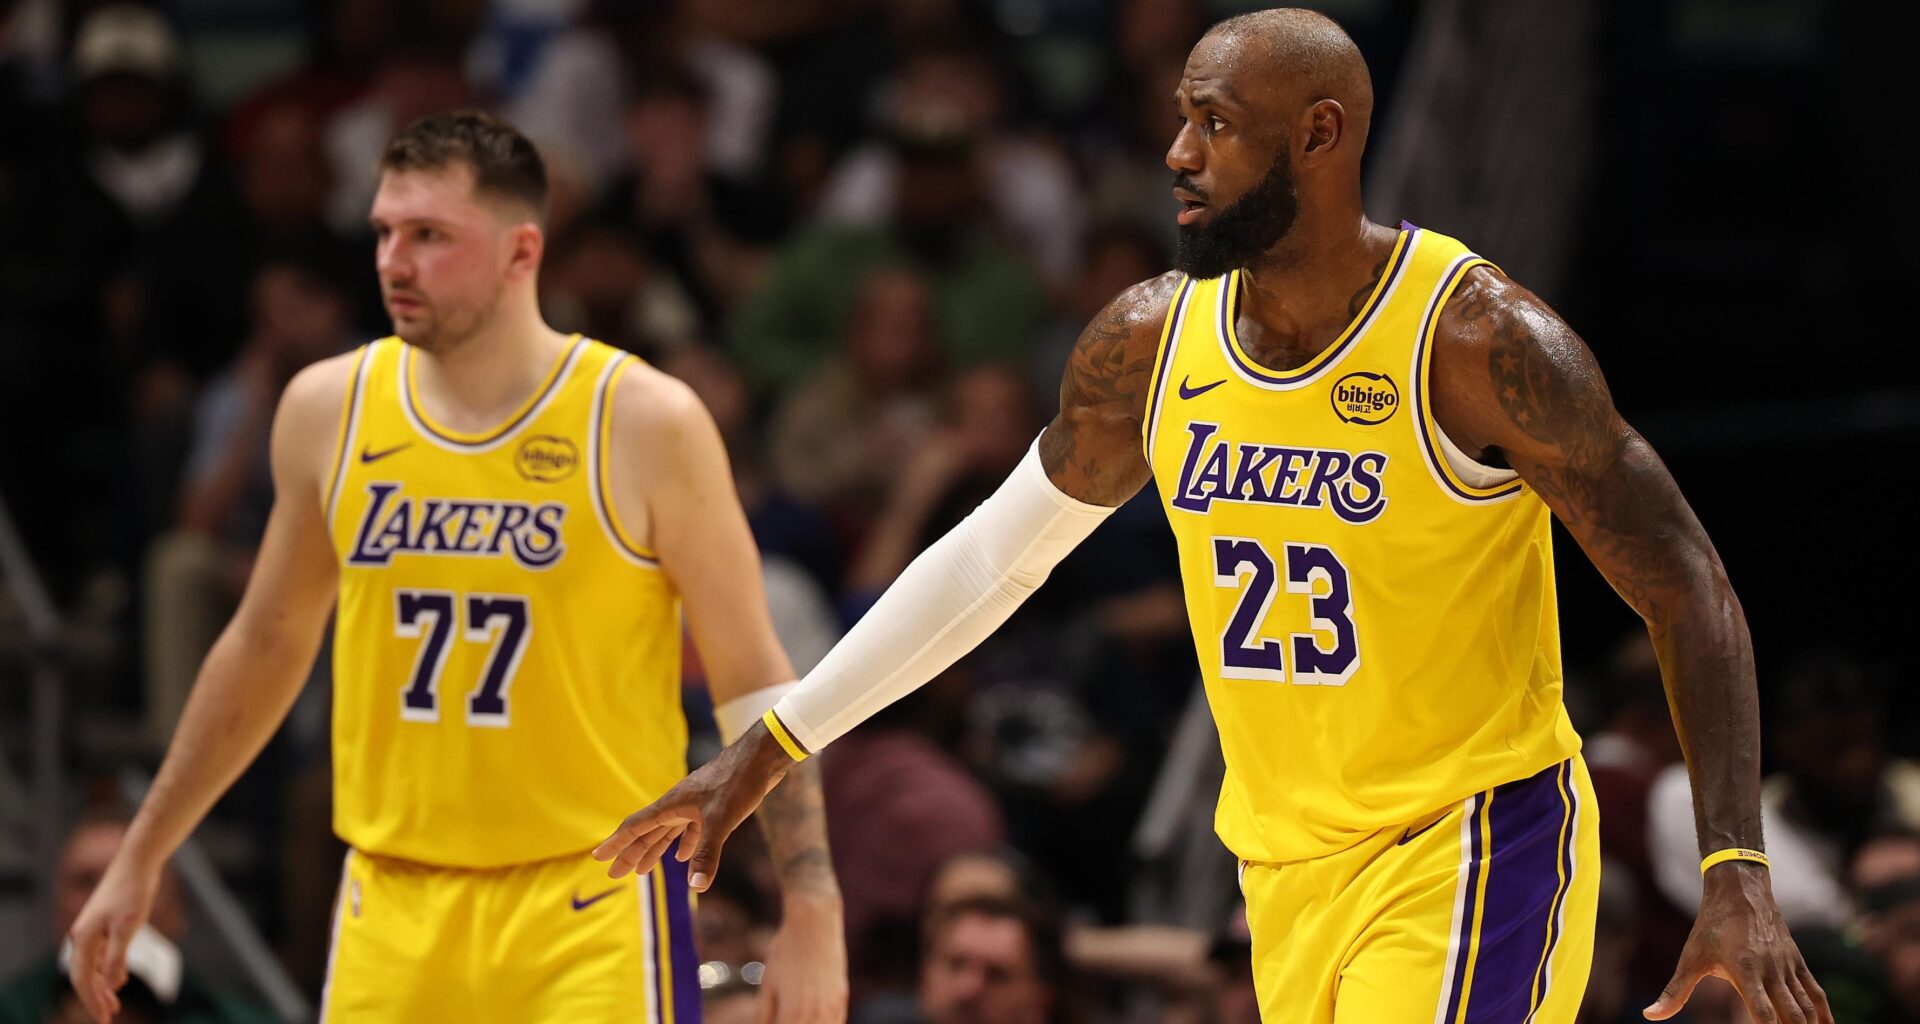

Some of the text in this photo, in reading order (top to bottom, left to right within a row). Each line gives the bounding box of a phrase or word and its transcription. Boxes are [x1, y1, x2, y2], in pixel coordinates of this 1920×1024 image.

[1338, 385, 1395, 411] bibigo
[1346, 403, 1372, 414] 비비고
[1172, 420, 1390, 526] LAKERS
[348, 482, 567, 570] LAKERS
[395, 588, 532, 728] 77
[1211, 536, 1361, 687] 23
